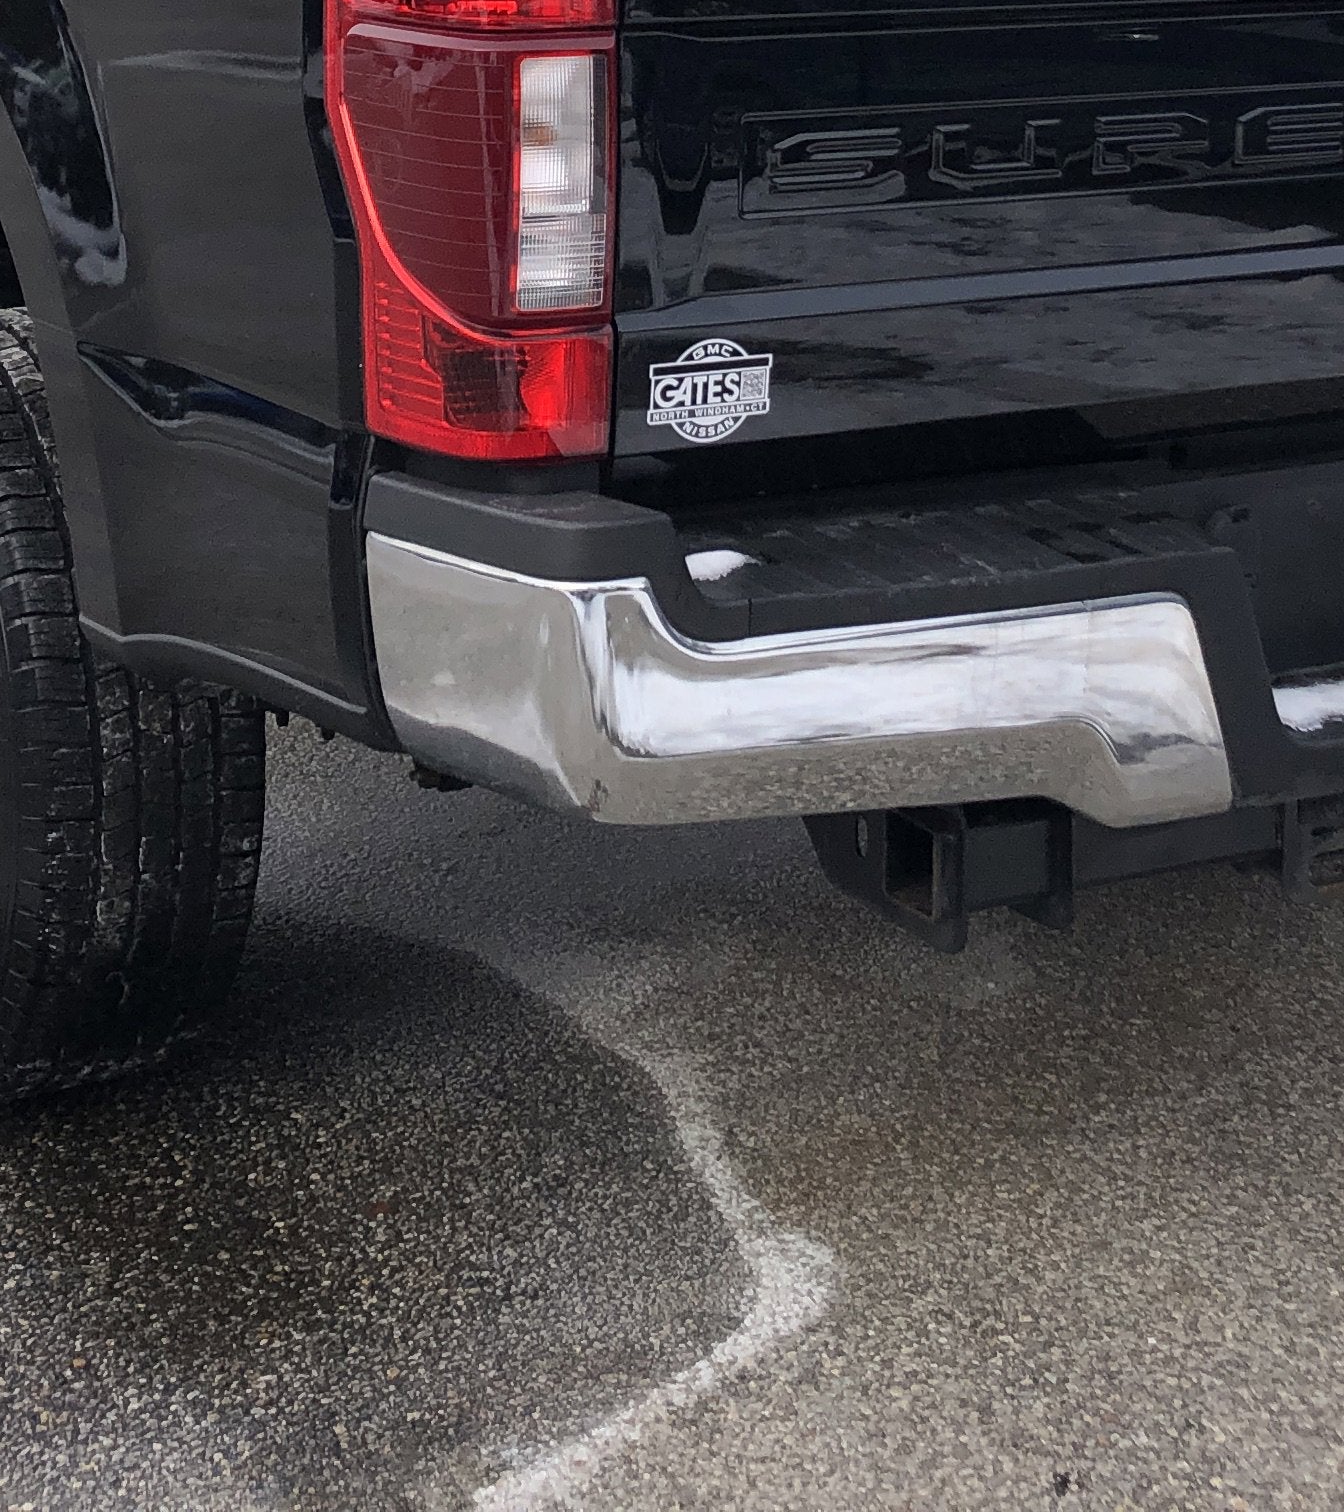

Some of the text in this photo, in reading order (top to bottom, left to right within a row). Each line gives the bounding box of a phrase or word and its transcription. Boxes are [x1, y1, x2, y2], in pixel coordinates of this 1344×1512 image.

[692, 343, 733, 360] GMC
[655, 373, 740, 408] GATES
[652, 409, 689, 422] NORTH
[682, 417, 735, 437] NISSAN
